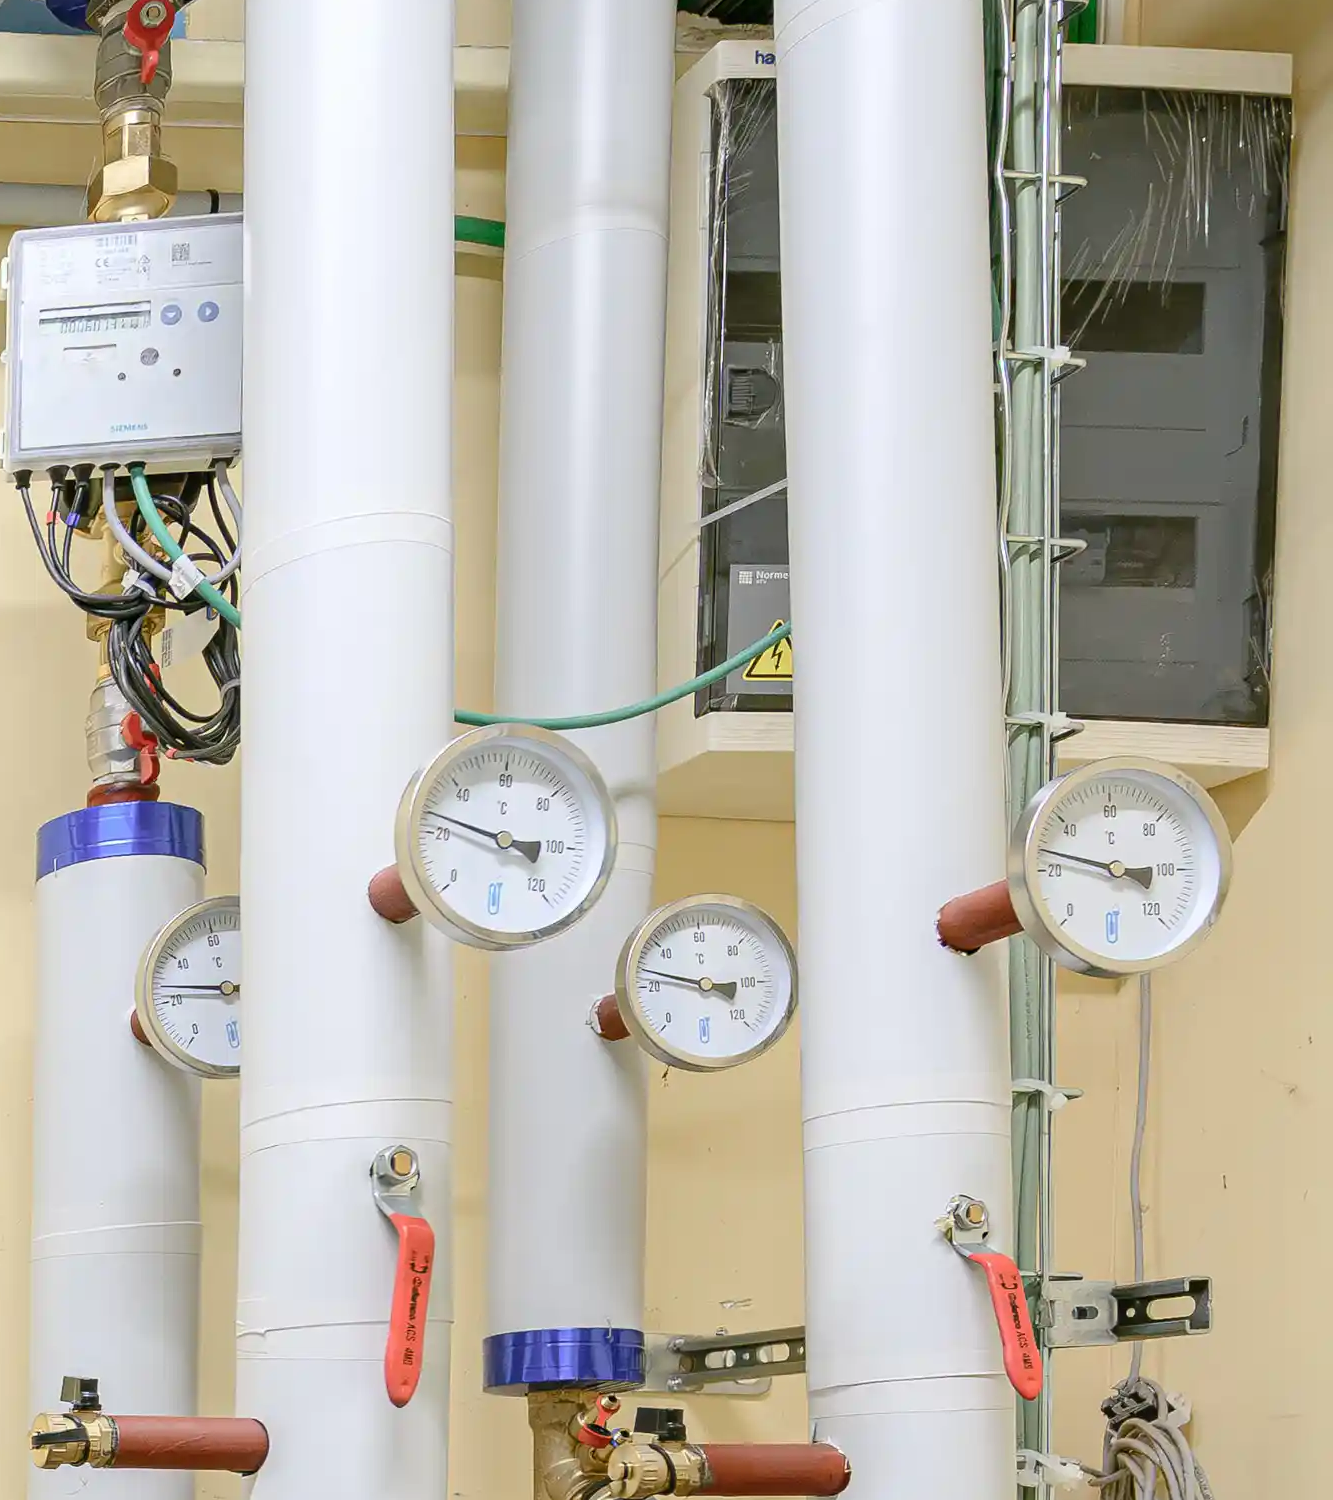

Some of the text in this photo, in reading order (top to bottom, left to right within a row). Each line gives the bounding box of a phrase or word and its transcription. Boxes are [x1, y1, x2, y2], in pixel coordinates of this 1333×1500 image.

[755, 50, 776, 66] ha
[110, 422, 149, 433] SIEMENS
[500, 774, 513, 787] 60
[456, 788, 469, 801] 40
[537, 798, 549, 811] 80
[1104, 805, 1116, 817] 60
[435, 827, 450, 841] 20
[1064, 824, 1076, 836] 40
[1143, 823, 1155, 836] 80
[547, 840, 563, 853] 100
[451, 869, 457, 882] 0
[1048, 864, 1061, 876] 20
[1157, 863, 1174, 876] 100
[528, 878, 545, 892] 120
[1067, 903, 1073, 916] 0
[1143, 903, 1159, 915] 120
[208, 935, 219, 947] 60
[694, 932, 704, 942] 60
[661, 948, 671, 958] 40
[728, 945, 738, 956] 80
[178, 959, 188, 969] 40
[649, 981, 660, 992] 20
[741, 977, 755, 988] 100
[170, 995, 182, 1007] 20
[666, 1013, 671, 1023] 0
[730, 1009, 745, 1019] 120
[192, 1024, 198, 1034] 0
